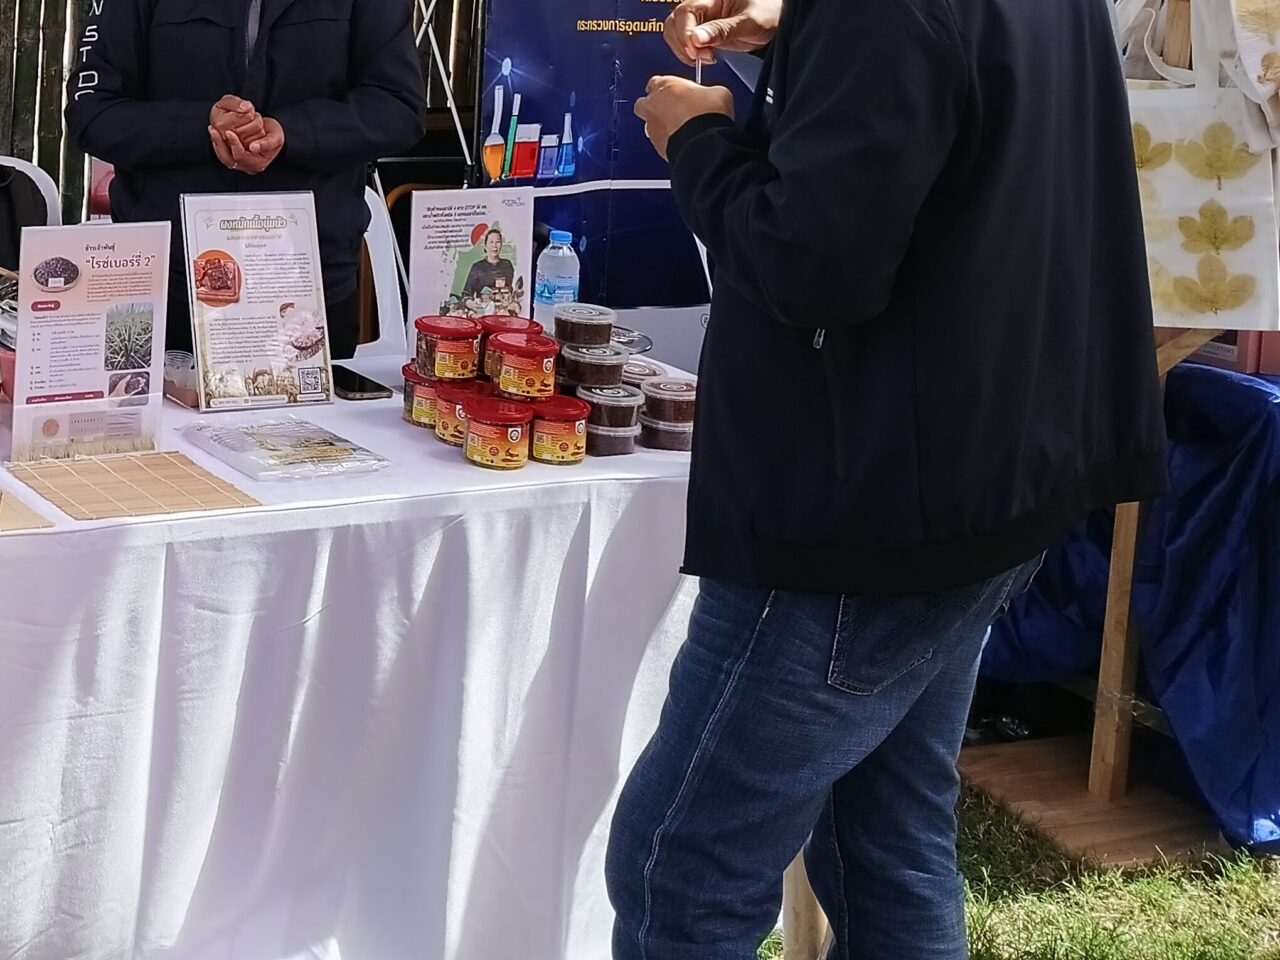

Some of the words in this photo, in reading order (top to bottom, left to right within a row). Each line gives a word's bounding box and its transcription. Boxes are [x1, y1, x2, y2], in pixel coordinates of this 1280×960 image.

[577, 18, 664, 36] กระทรวงการอุดมศึก
